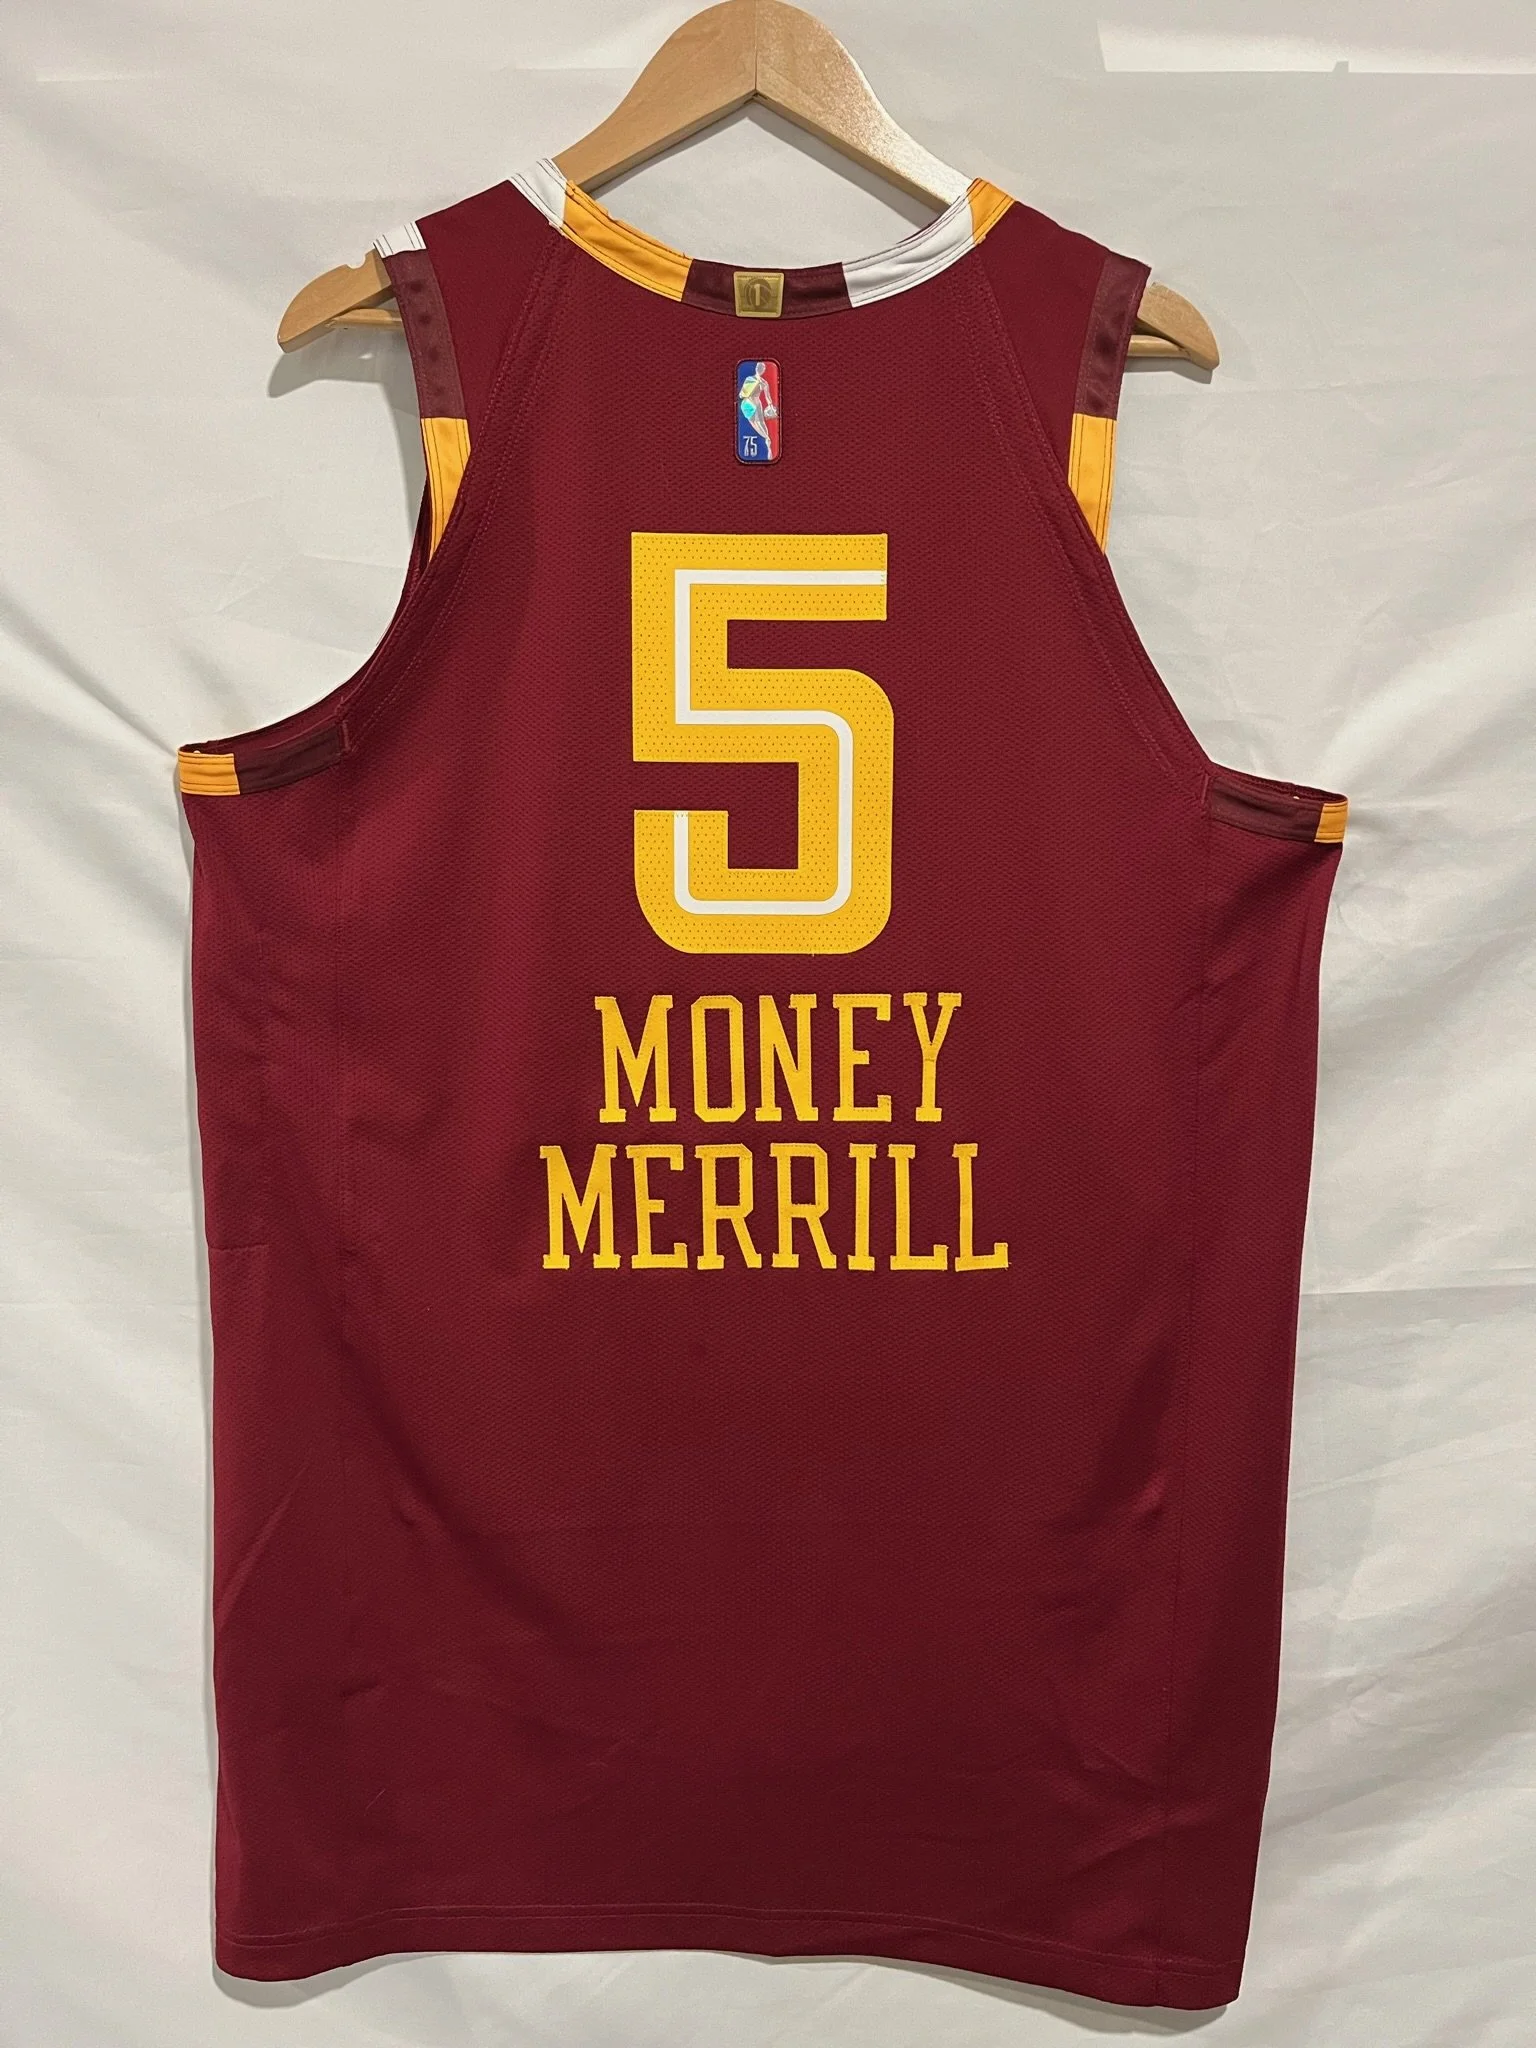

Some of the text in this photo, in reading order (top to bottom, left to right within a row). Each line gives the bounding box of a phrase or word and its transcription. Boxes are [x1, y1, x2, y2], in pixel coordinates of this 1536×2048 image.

[743, 435, 758, 457] 75
[631, 532, 894, 955] 5
[594, 992, 962, 1123] MONEY
[539, 1143, 1009, 1272] MERRILL
